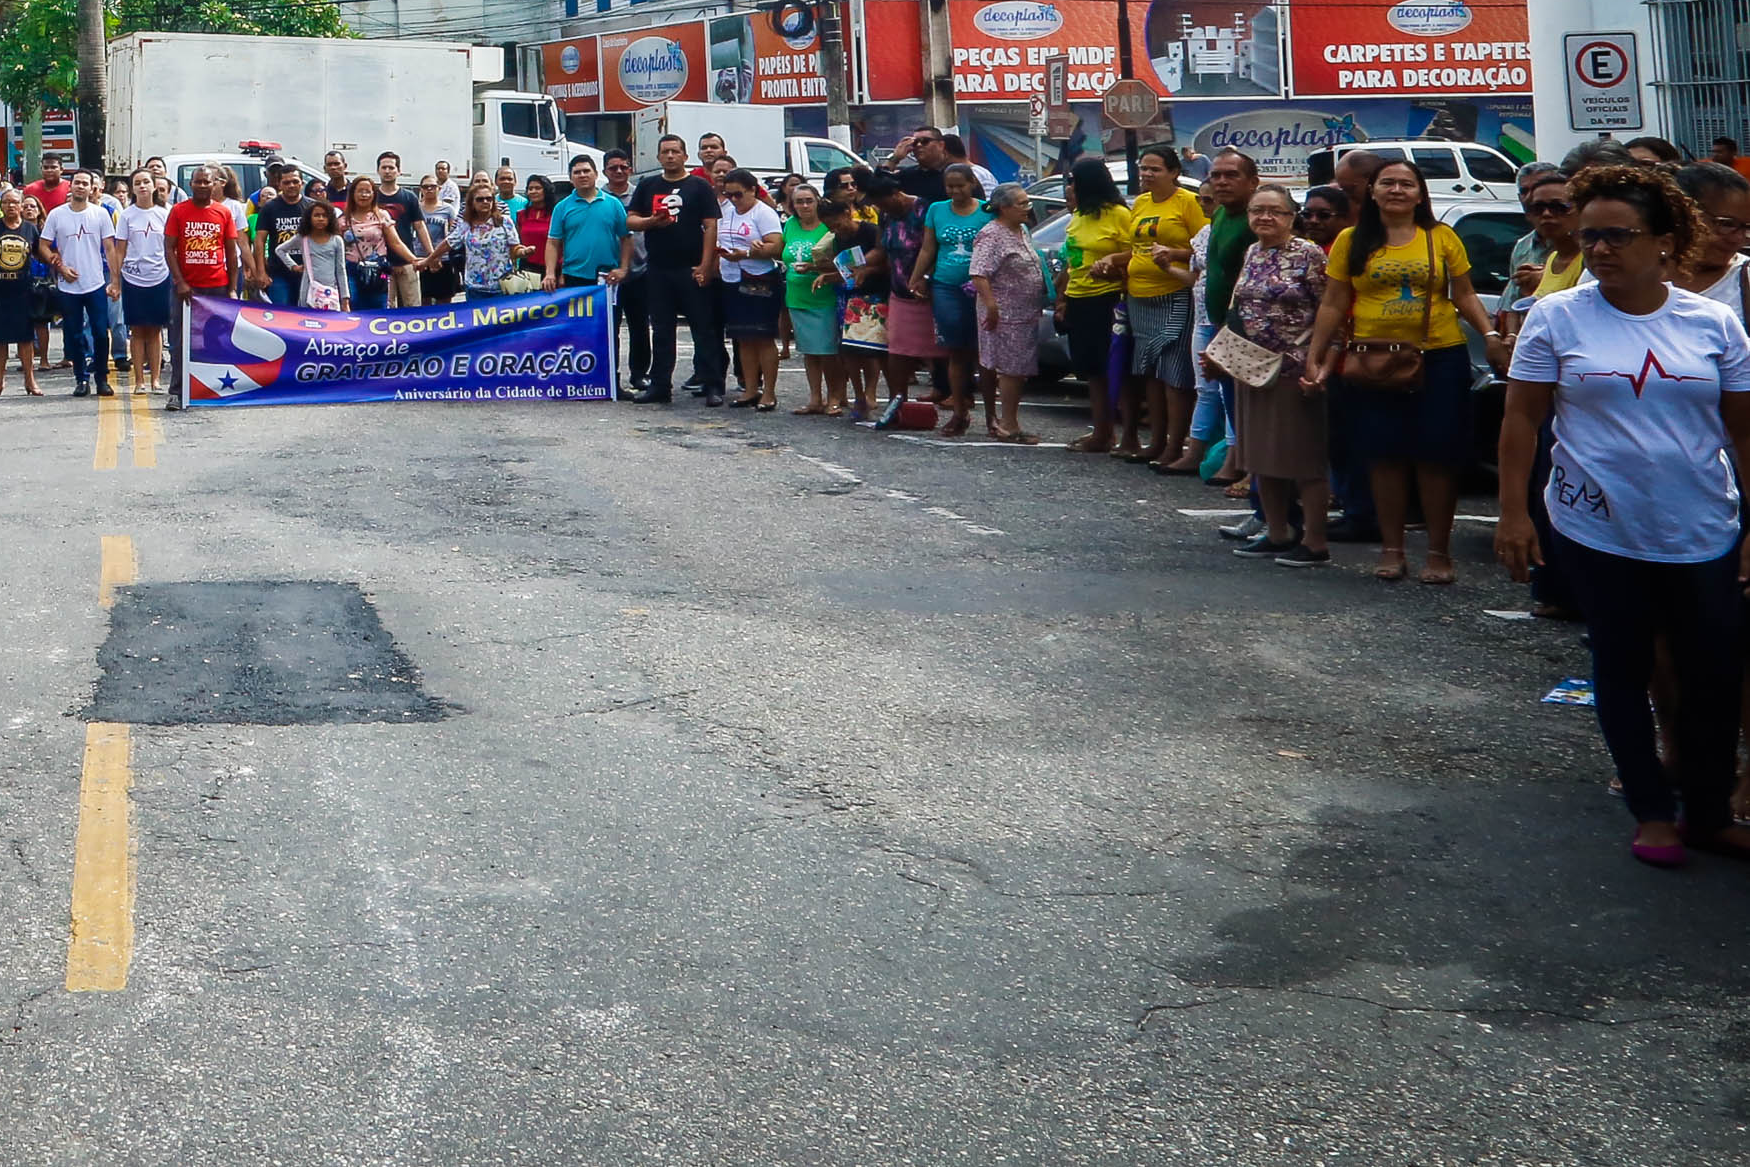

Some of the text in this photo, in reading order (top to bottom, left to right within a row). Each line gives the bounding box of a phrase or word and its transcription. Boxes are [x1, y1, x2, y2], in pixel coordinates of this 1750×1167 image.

[984, 7, 1053, 26] decoplast
[1396, 5, 1462, 22] decoplast
[758, 51, 791, 75] PAPÉIS
[793, 54, 806, 73] DE
[954, 47, 1021, 71] PEÇAS
[1067, 47, 1115, 65] MDF
[1323, 43, 1427, 63] CARPETES
[1434, 43, 1446, 61] E
[625, 48, 681, 82] decoplast
[1591, 51, 1613, 79] E
[760, 77, 828, 98] PRONTA ENTR
[954, 73, 998, 92] ARA
[1004, 67, 1123, 95] DECRAÇÃ
[1338, 63, 1527, 91] PARA DECORAÇÃO
[1108, 95, 1154, 113] PARE
[1212, 121, 1346, 156] decoplast
[185, 221, 221, 232] JUNTOS
[275, 217, 302, 225] JUNTO
[275, 224, 300, 232] SOMO
[184, 229, 214, 238] SOMOS
[185, 250, 209, 259] SOMOS
[369, 296, 593, 335] Coord. Marco III
[304, 337, 409, 363] Abraço de
[296, 345, 597, 383] GRATIDÃO E ORAÇÃO
[393, 384, 607, 401] Aniversário da Cidade de Belém
